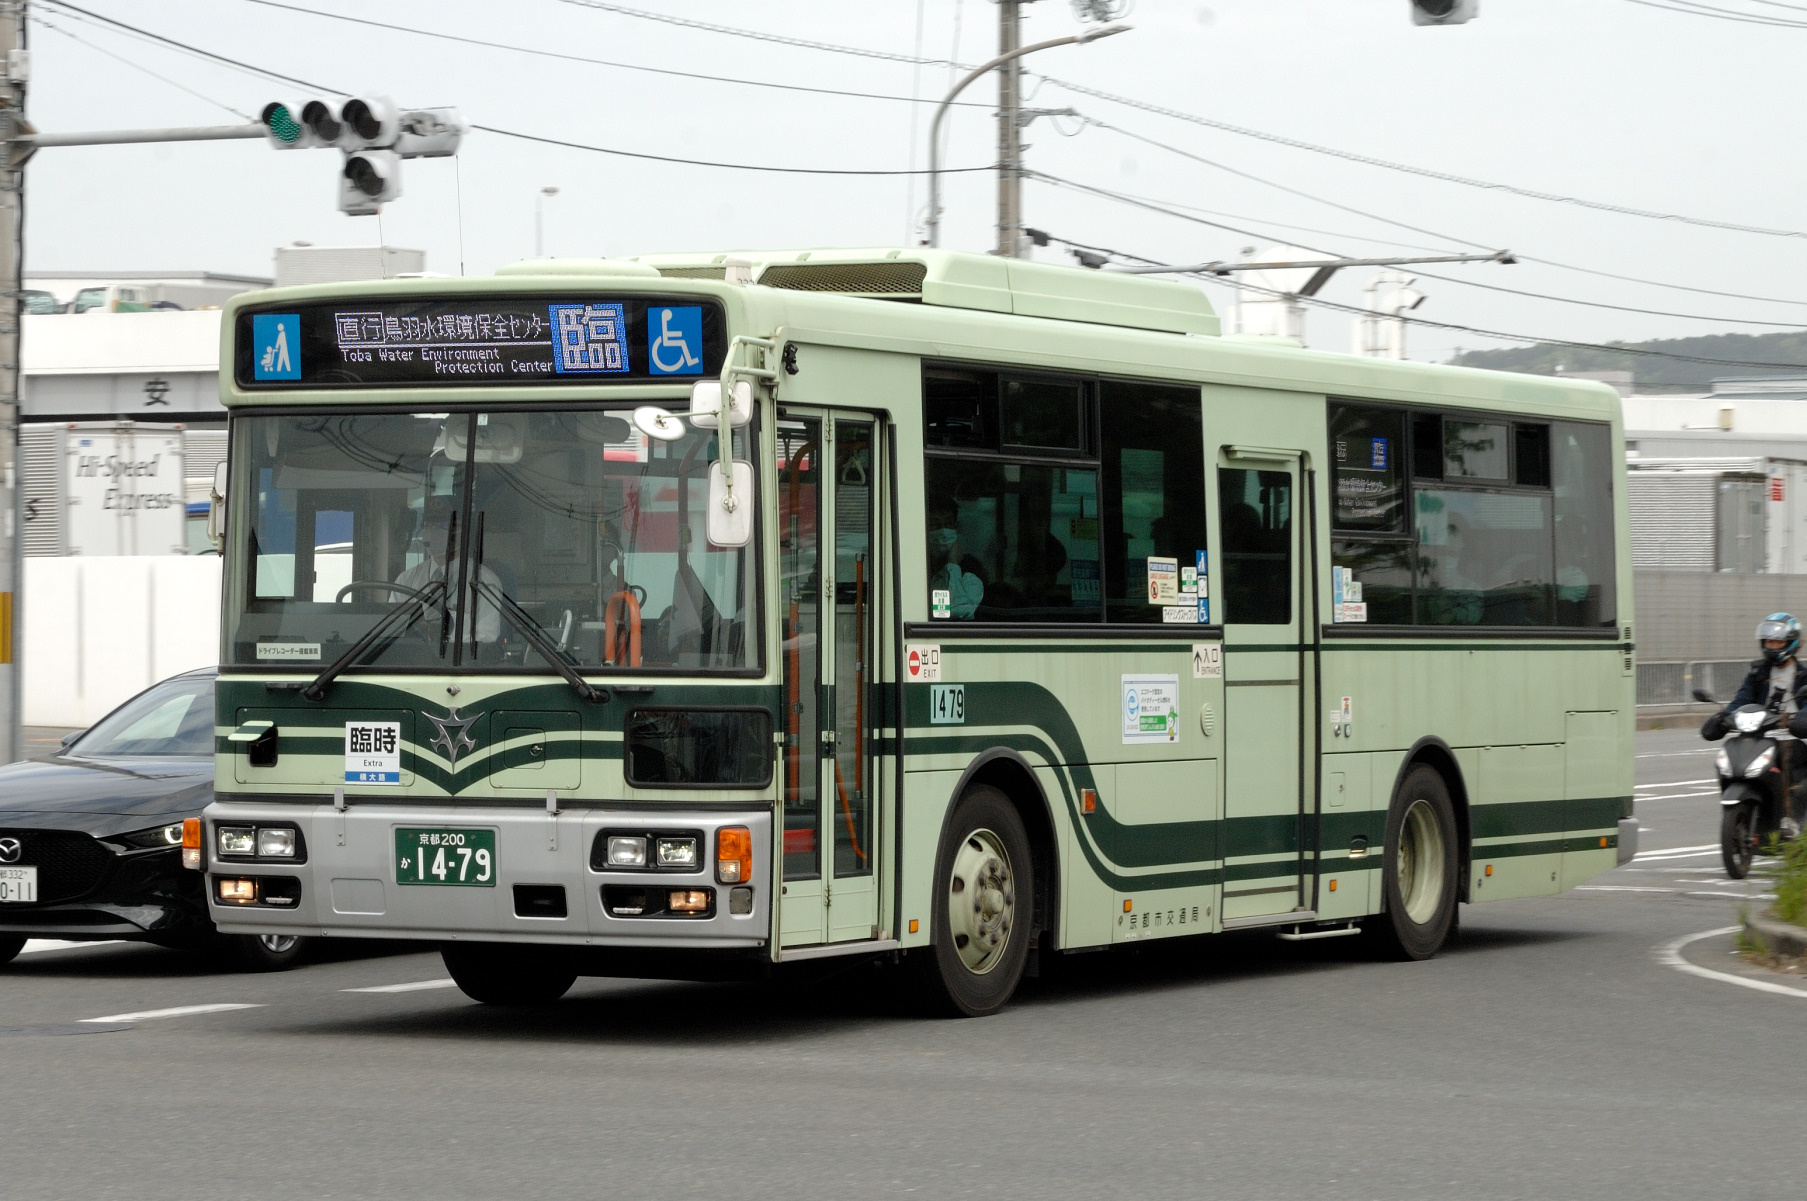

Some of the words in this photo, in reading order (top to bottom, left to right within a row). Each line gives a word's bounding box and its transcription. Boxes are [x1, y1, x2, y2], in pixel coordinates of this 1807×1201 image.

[558, 306, 623, 369] 臨
[340, 349, 372, 362] Toba
[378, 350, 414, 362] Water
[421, 348, 500, 361] Environment
[434, 361, 504, 374] Protection
[511, 360, 553, 373] Center
[143, 378, 170, 406] 安
[921, 648, 939, 665] 出口
[1203, 648, 1219, 663] 入口
[923, 669, 937, 678] EXIT
[933, 689, 964, 719] 1479
[350, 726, 397, 753] 臨時
[363, 759, 383, 767] Extra
[400, 857, 411, 869] か
[417, 847, 491, 882] 14-79
[1130, 907, 1199, 929] 京都市交通局
